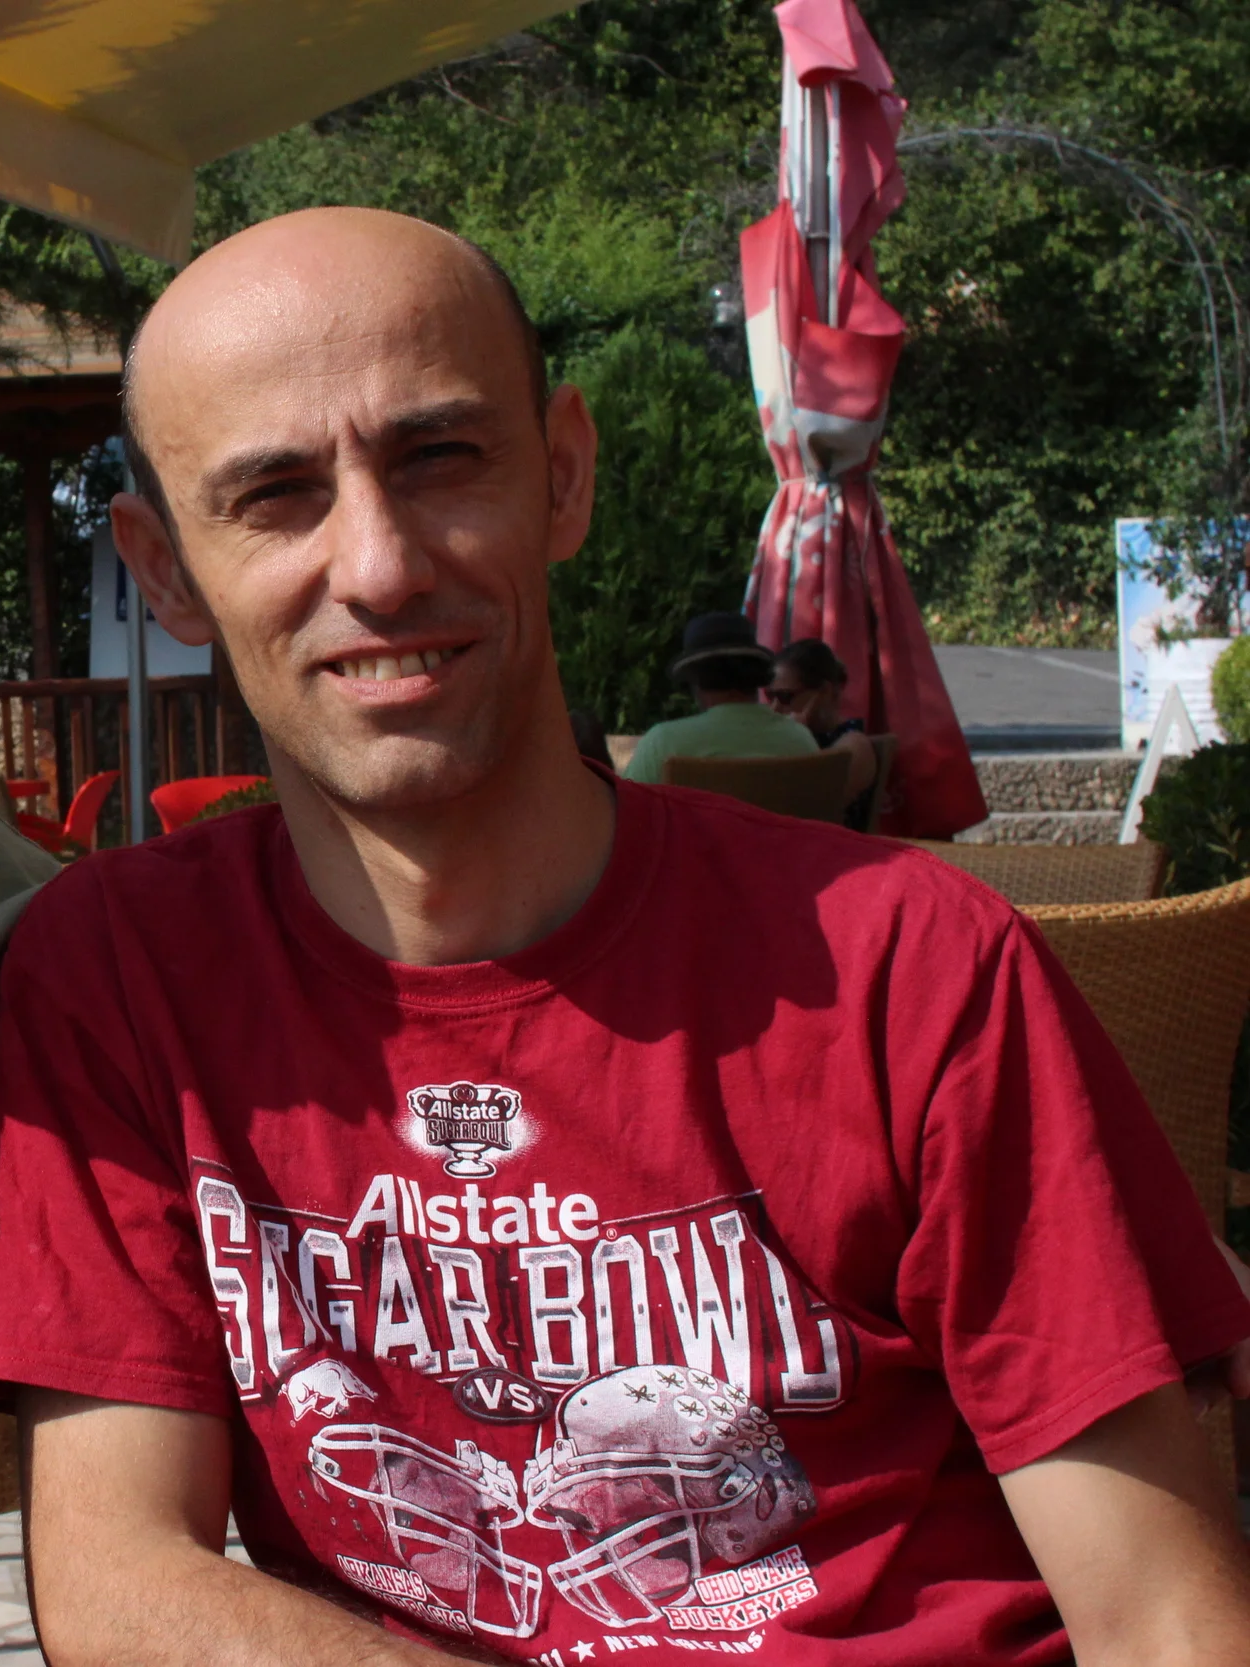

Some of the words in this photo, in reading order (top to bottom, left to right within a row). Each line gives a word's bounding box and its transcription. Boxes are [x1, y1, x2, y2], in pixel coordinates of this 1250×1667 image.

[427, 1100, 501, 1120] Allstate
[346, 1174, 599, 1244] Allstate
[518, 1210, 842, 1404] BOWL
[473, 1378, 535, 1413] VS
[695, 1570, 745, 1605] OHIO
[738, 1544, 810, 1595] STATE
[661, 1576, 819, 1631] BUCKEYES
[603, 1635, 659, 1653] NEW
